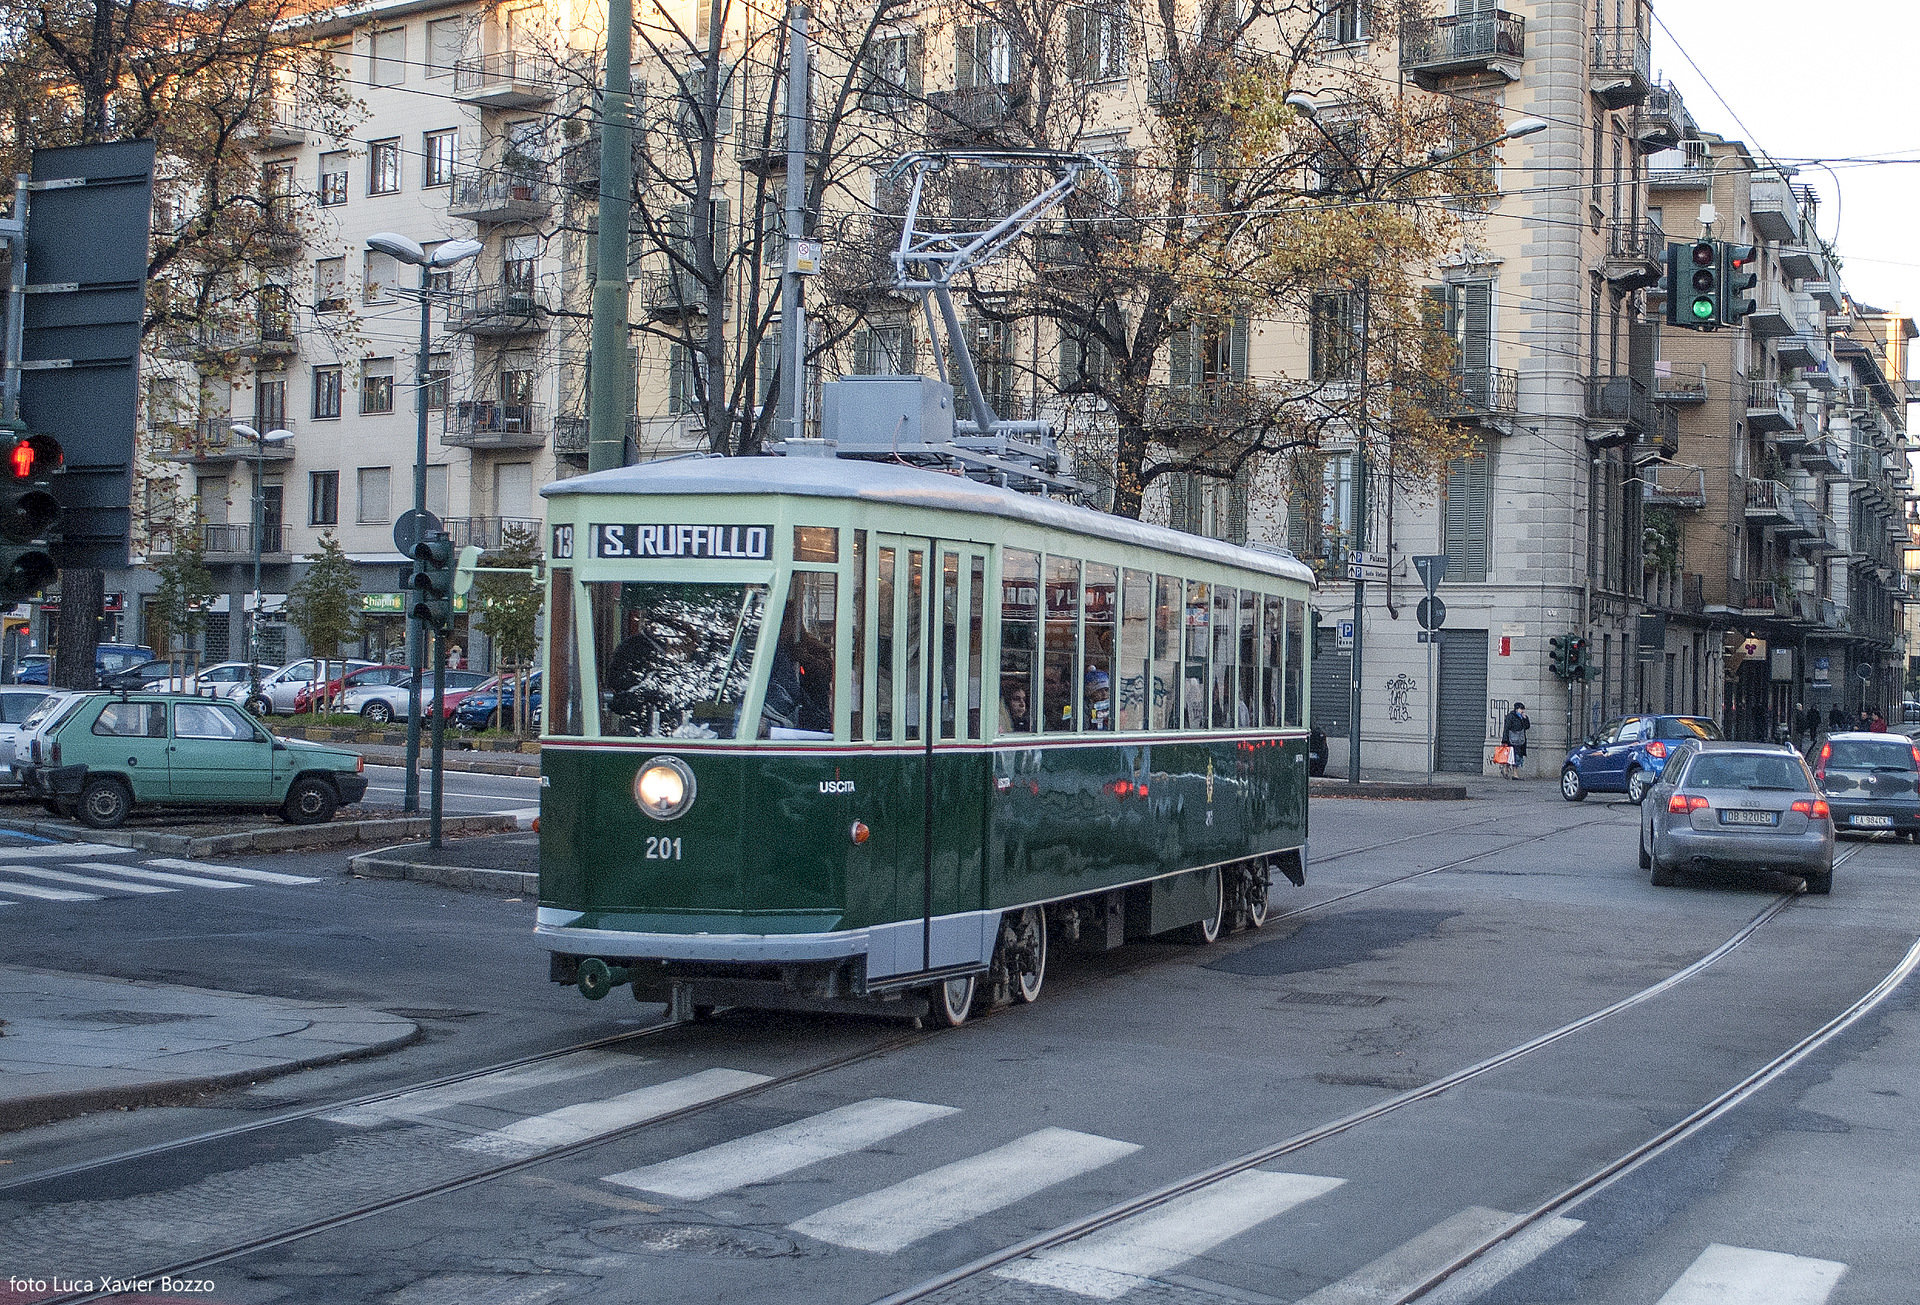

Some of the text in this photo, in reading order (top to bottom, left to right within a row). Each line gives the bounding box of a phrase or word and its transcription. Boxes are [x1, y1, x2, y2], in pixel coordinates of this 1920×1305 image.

[555, 526, 573, 557] 13
[604, 525, 767, 558] S. RUFFILLO
[819, 780, 856, 793] USCITA
[646, 836, 682, 860] 201
